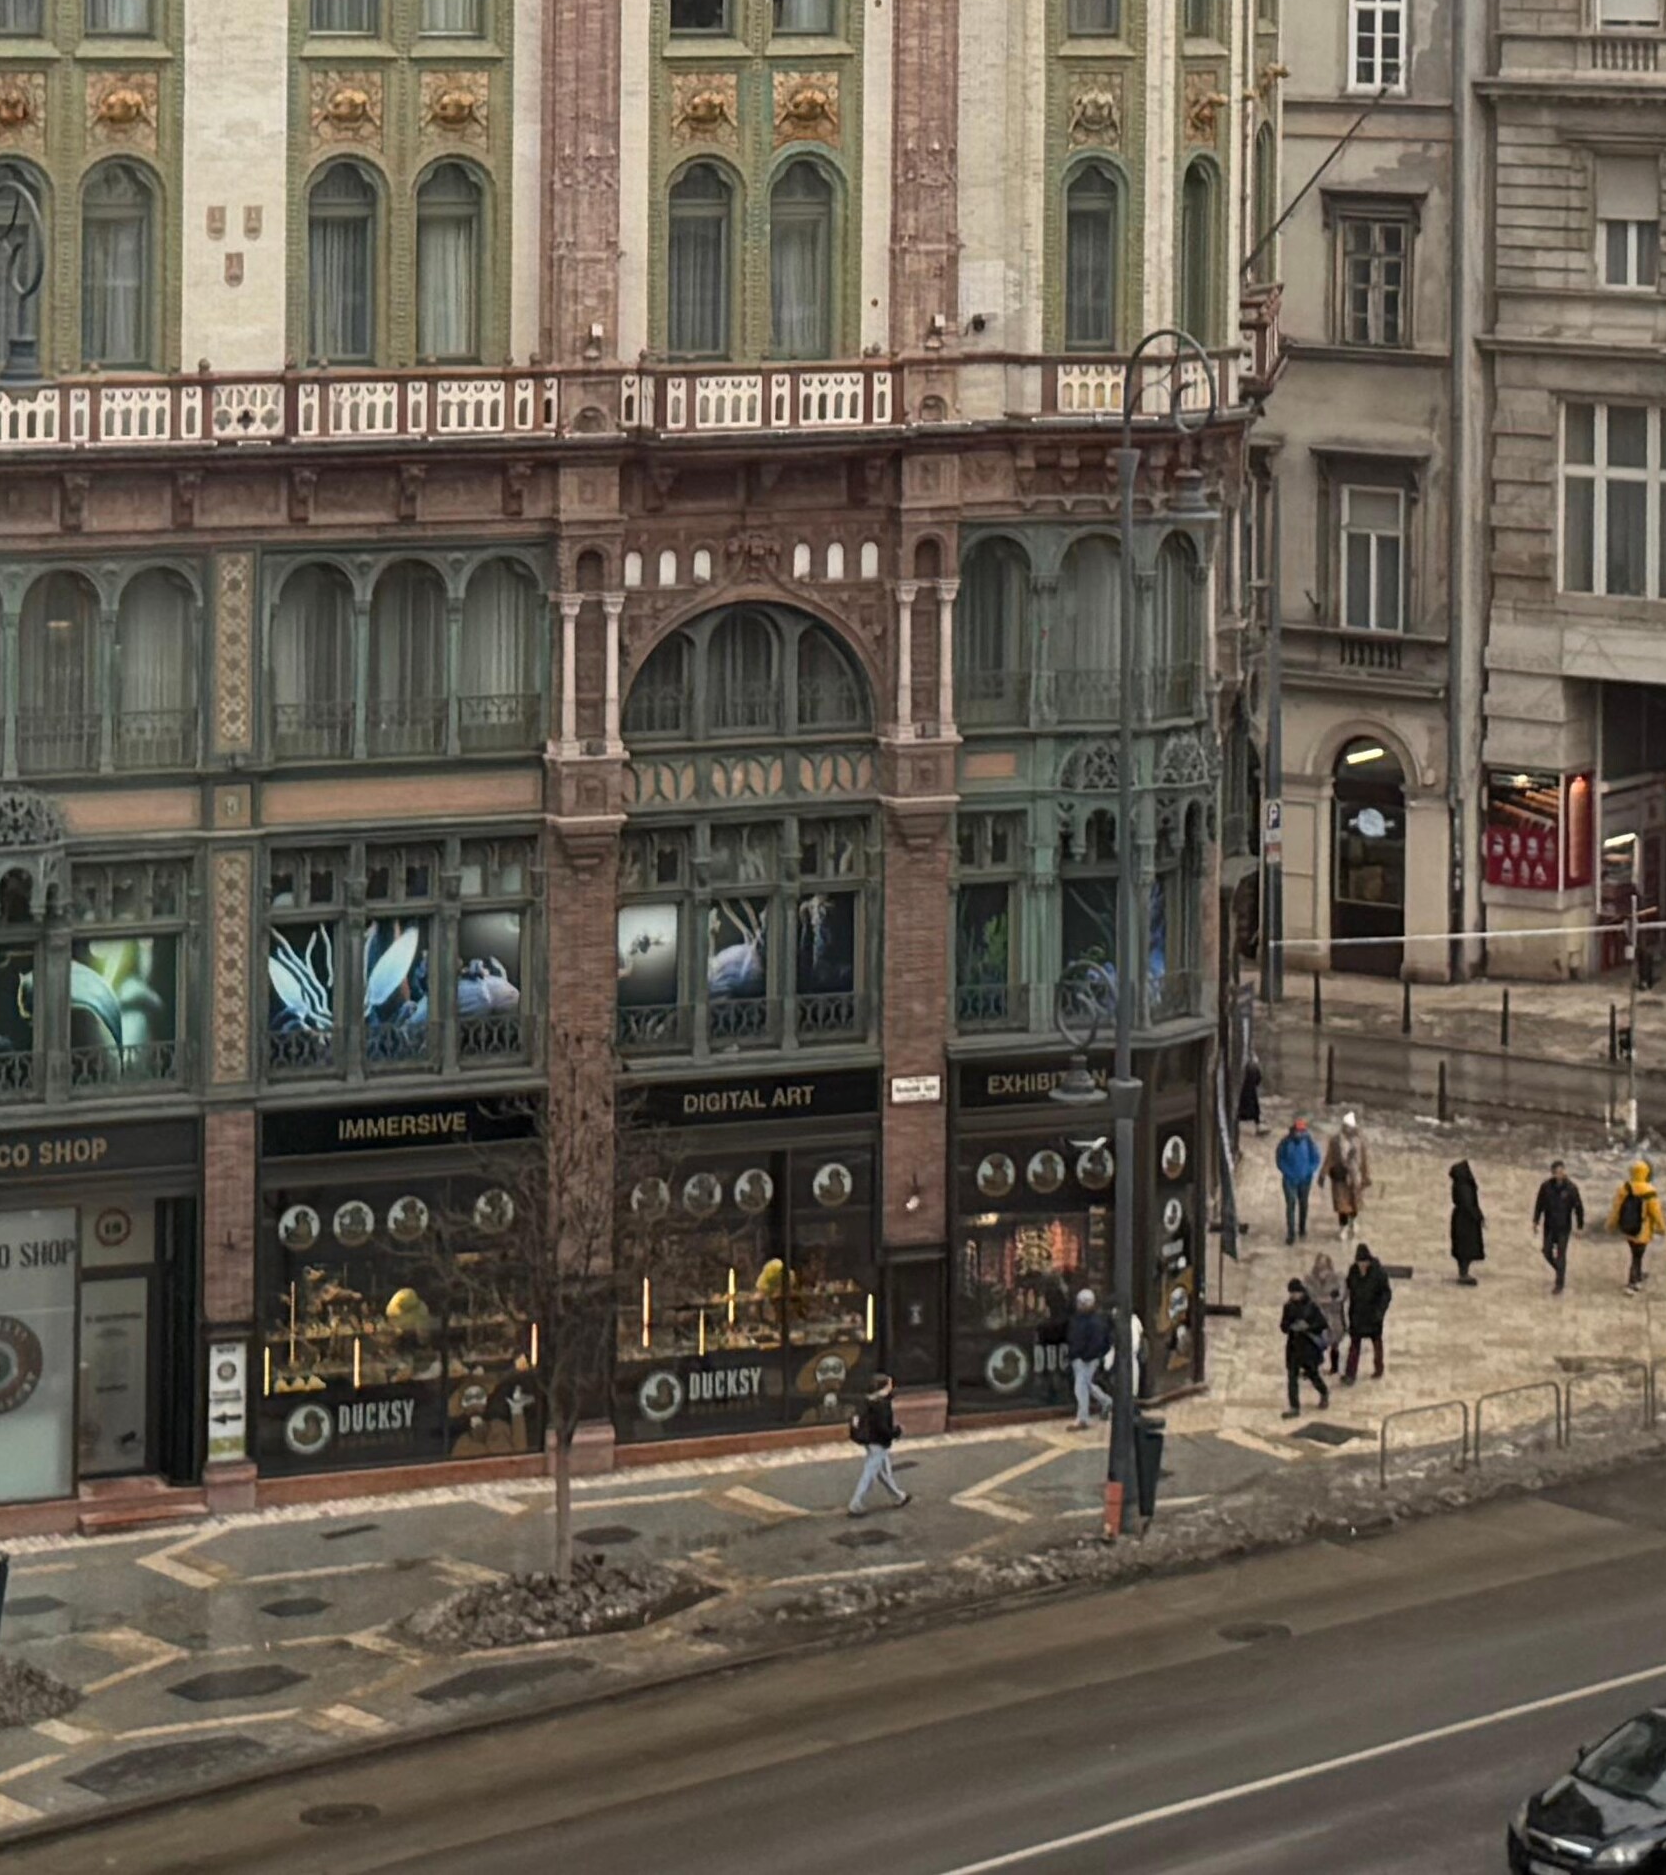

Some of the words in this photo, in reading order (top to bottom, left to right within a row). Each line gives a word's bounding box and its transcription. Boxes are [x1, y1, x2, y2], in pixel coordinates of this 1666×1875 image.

[988, 1069, 1107, 1094] EXHIBITN
[684, 1089, 767, 1113] DIGITAL
[771, 1085, 815, 1108] ART
[338, 1111, 467, 1141] IMMERSIVE
[39, 1136, 108, 1166] SHOP
[19, 1238, 75, 1269] SHOP
[689, 1367, 761, 1401] DUCKSY
[338, 1399, 415, 1434] DUCKSY
